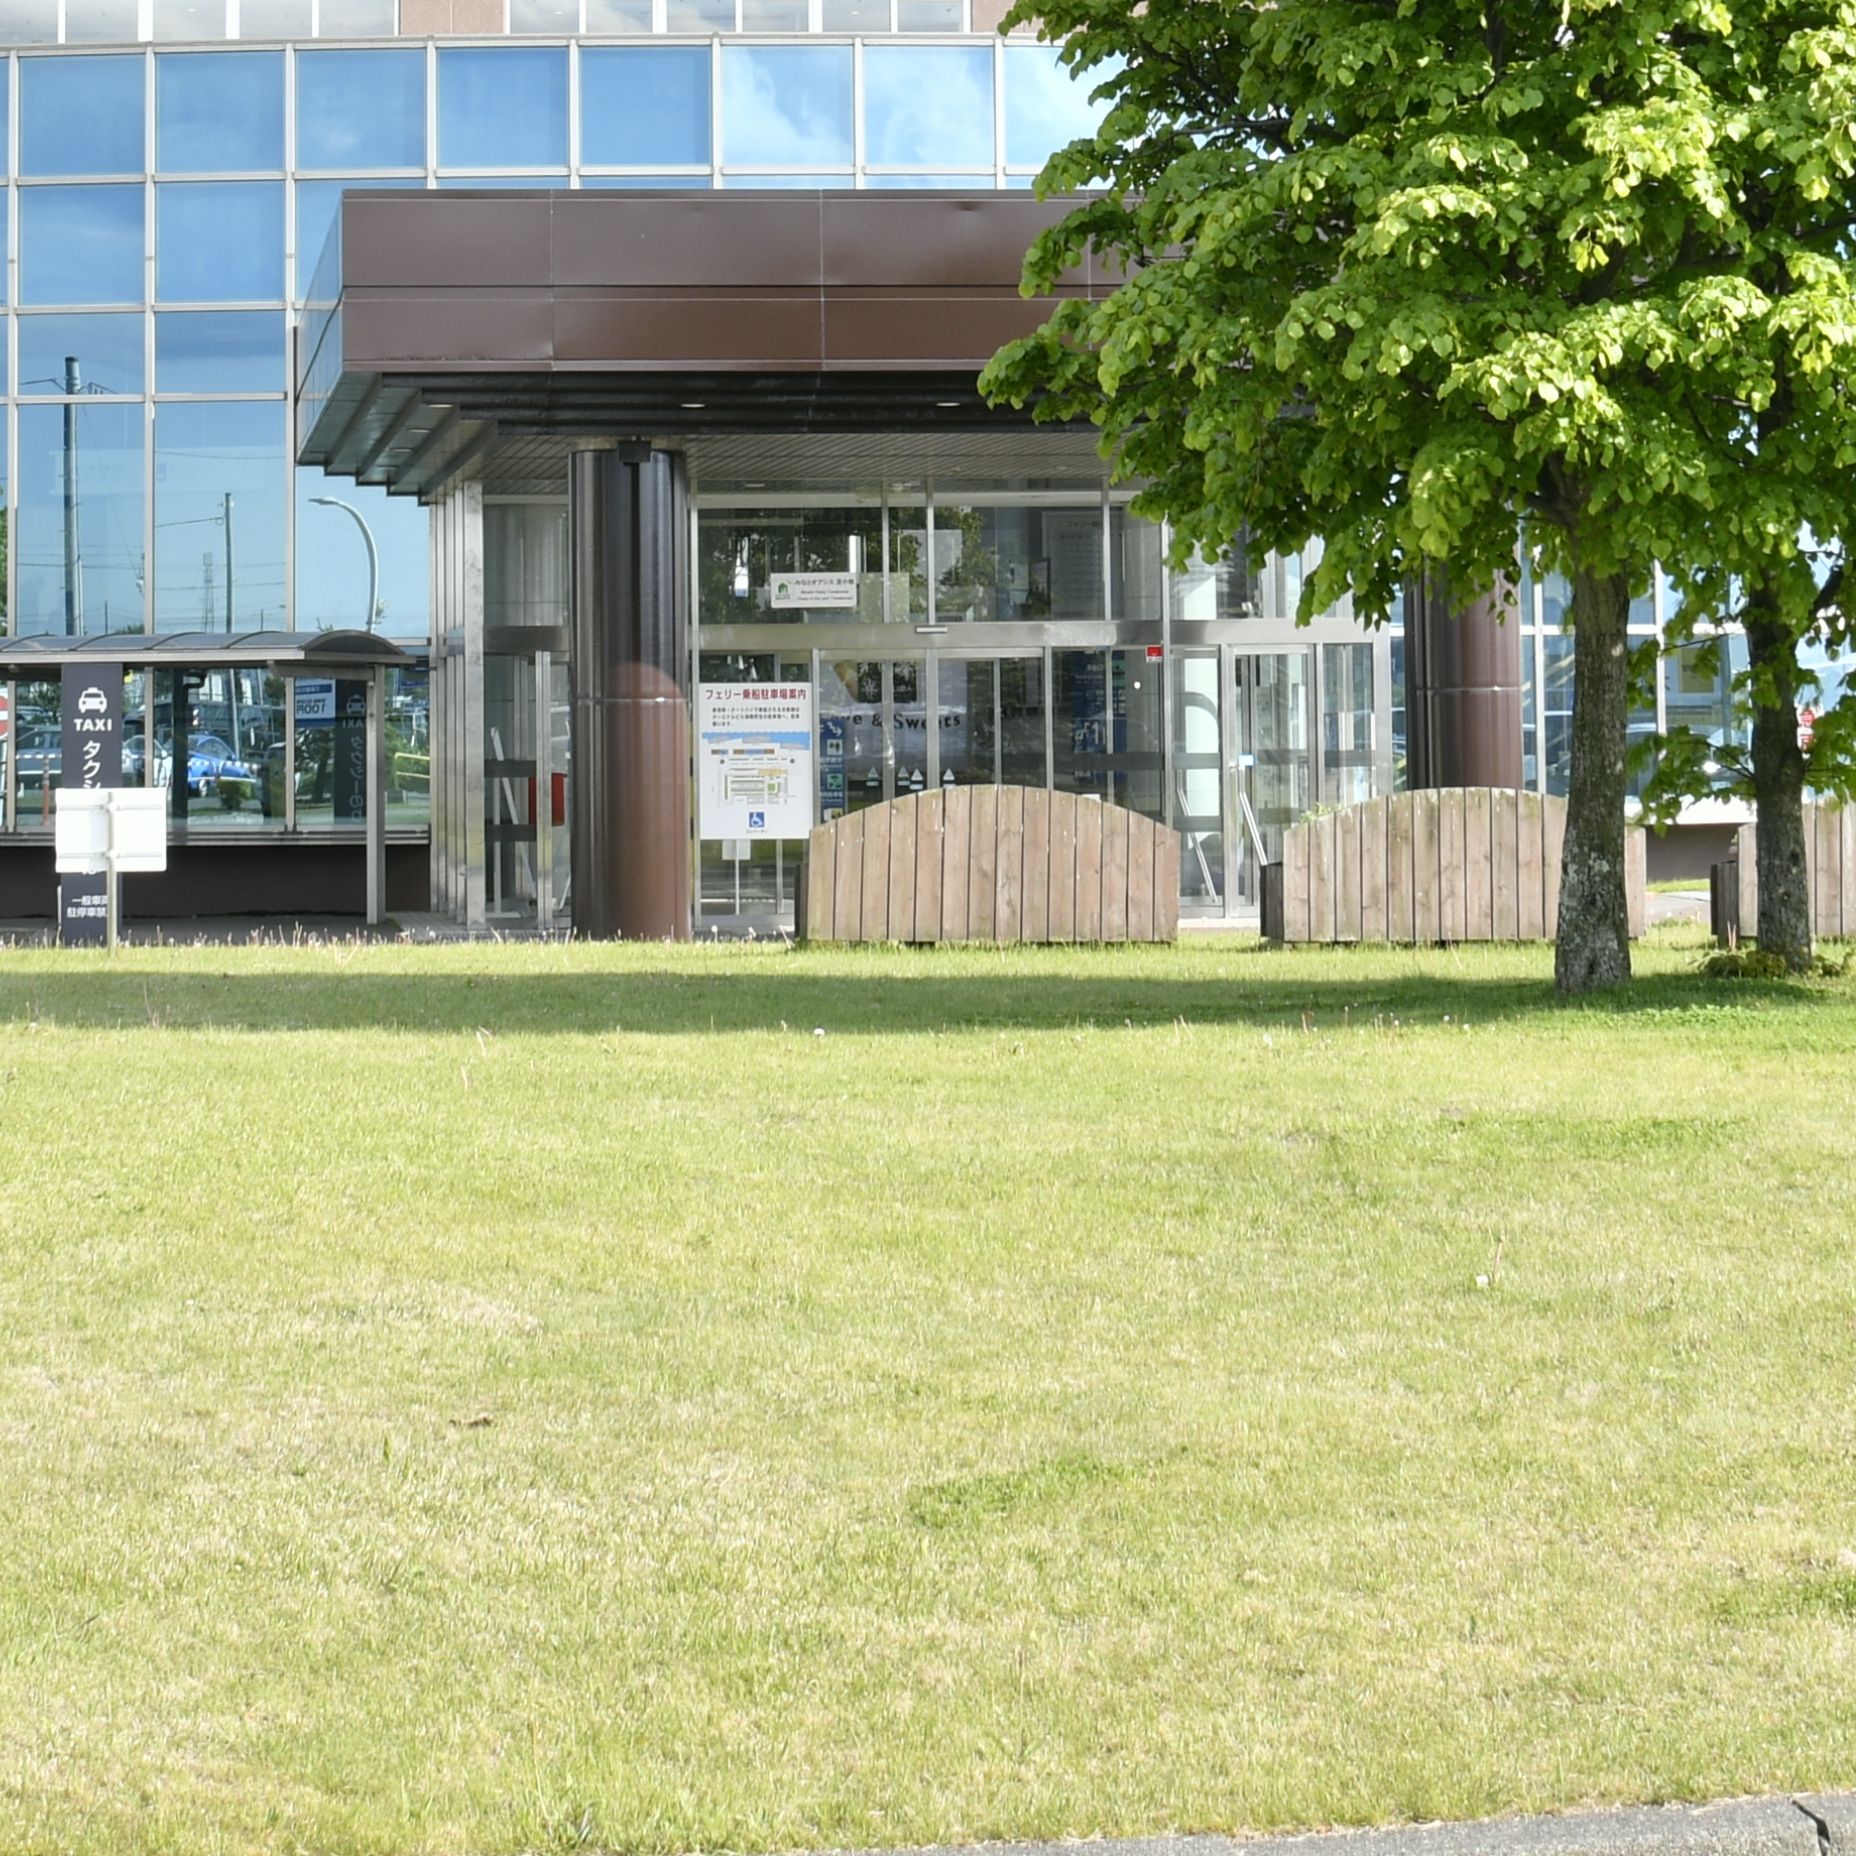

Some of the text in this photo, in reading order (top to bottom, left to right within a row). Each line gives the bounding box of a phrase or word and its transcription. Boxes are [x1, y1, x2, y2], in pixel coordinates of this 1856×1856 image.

[705, 688, 807, 701] フェリー乗船駐車場案内
[73, 718, 112, 732] TAXI
[893, 713, 961, 730] Swets
[66, 907, 108, 918] 駐停車禁
